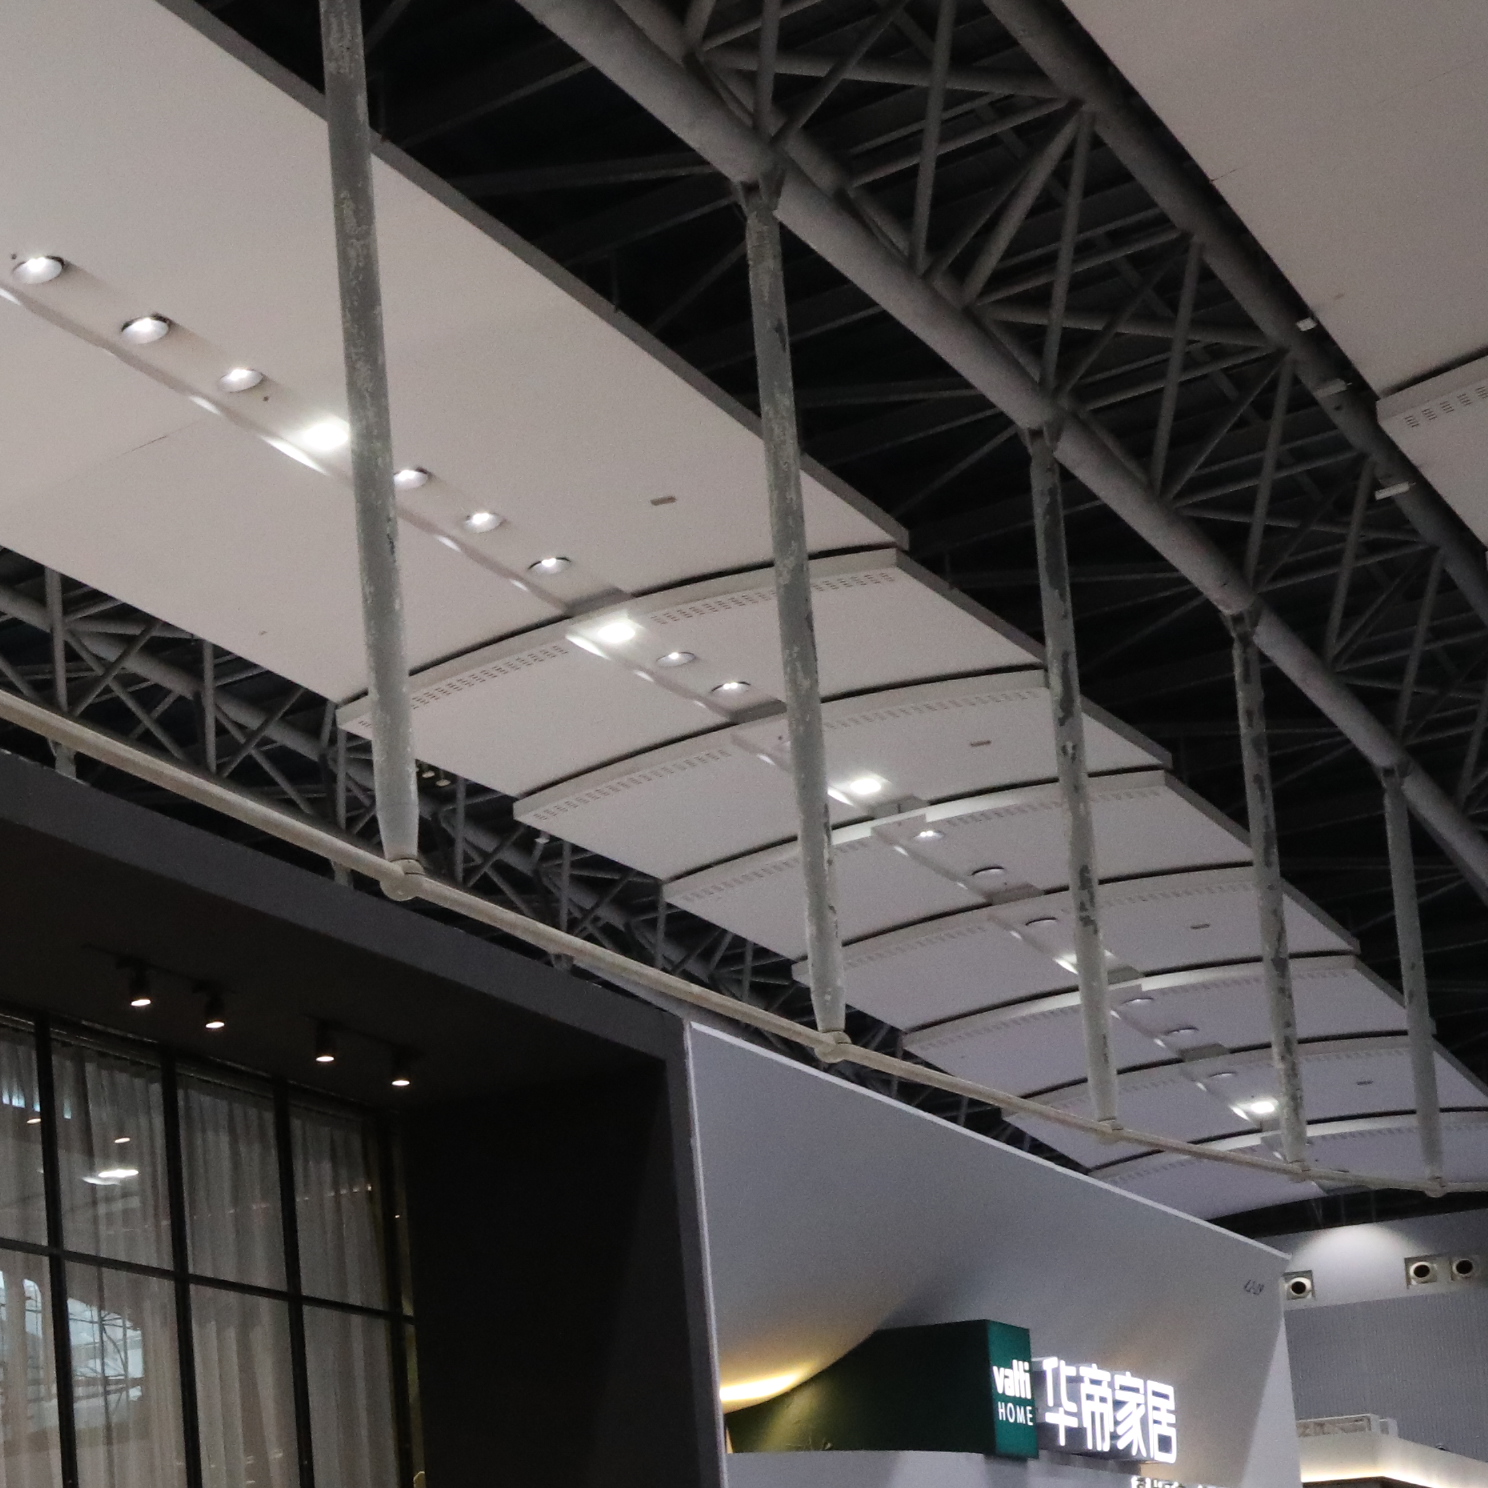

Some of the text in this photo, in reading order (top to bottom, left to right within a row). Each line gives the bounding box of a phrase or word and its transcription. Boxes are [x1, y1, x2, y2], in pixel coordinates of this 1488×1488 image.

[997, 1401, 1034, 1426] HOME
[1042, 1356, 1177, 1463] 华帝家居
